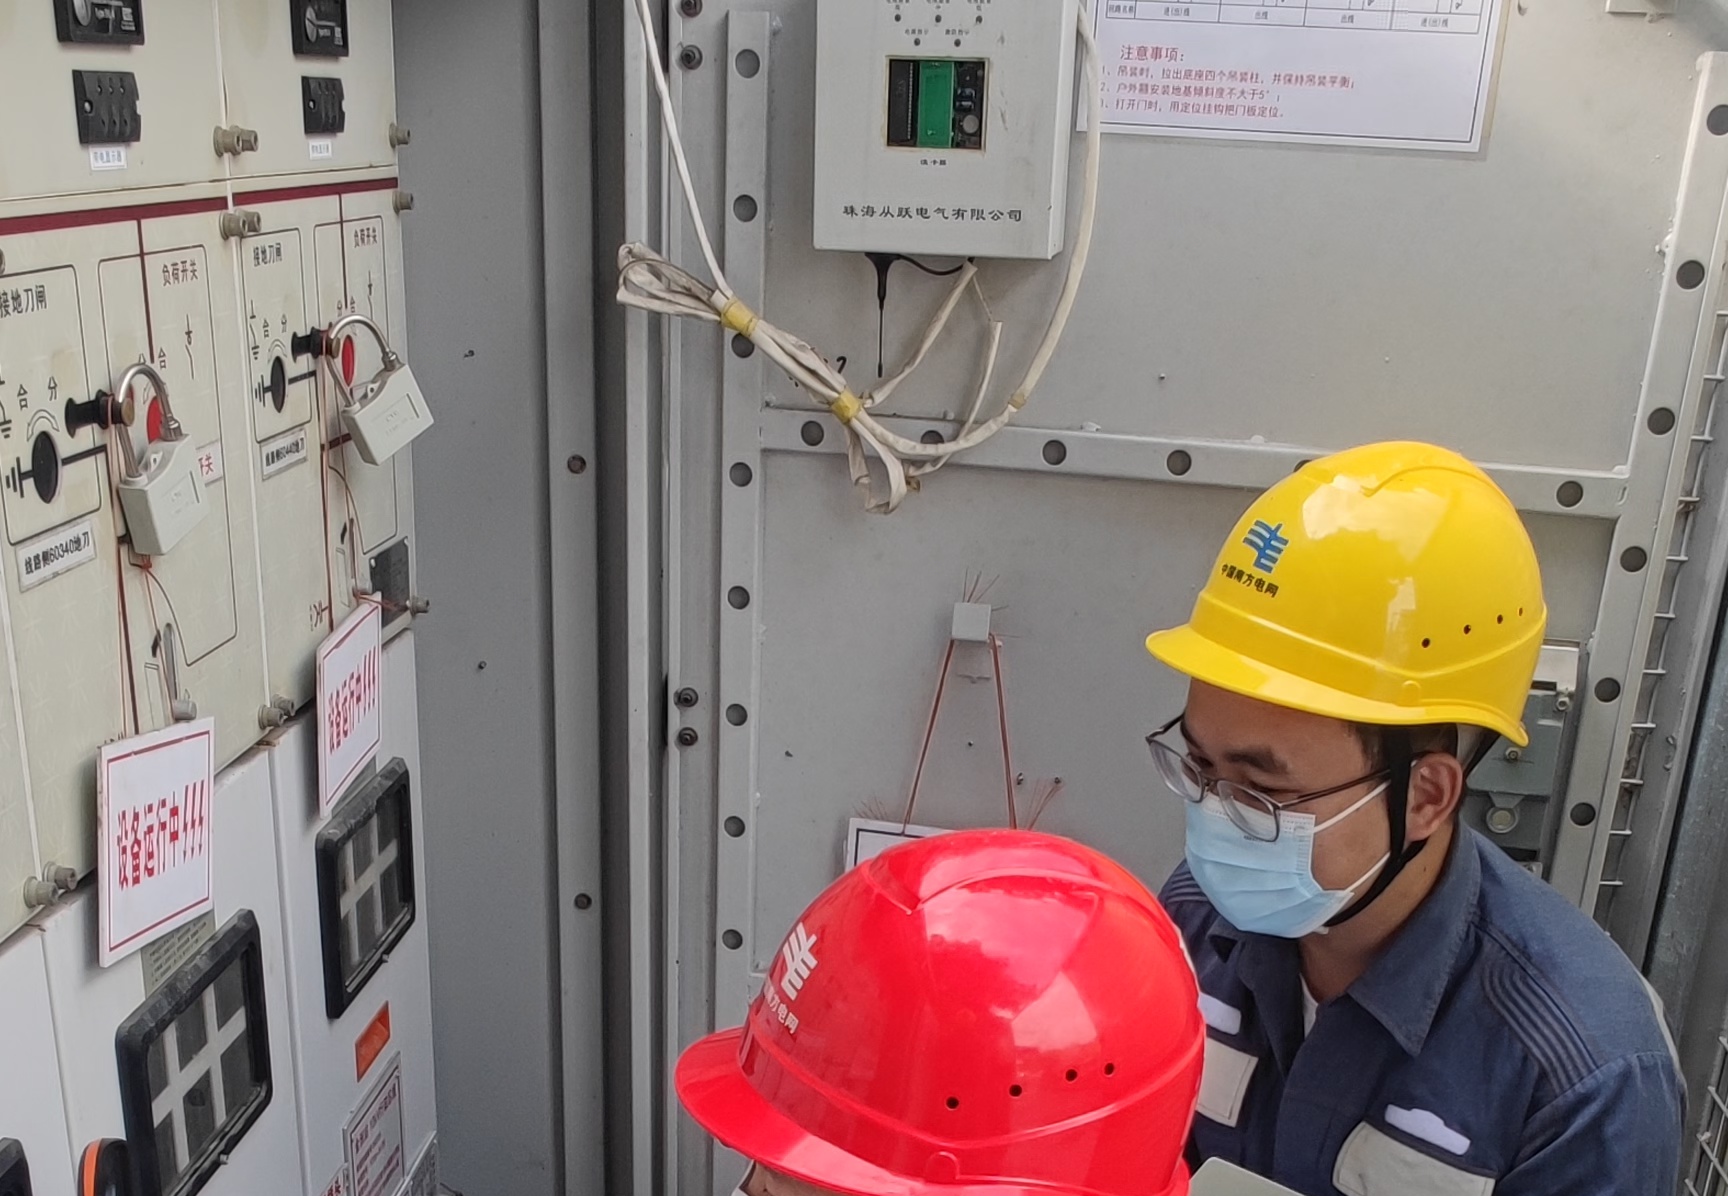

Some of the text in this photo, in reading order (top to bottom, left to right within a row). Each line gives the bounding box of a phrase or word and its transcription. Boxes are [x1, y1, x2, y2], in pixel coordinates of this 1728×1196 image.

[843, 205, 1022, 222] 珠海从跃电气有限公司
[117, 797, 180, 892] 设备运行中
